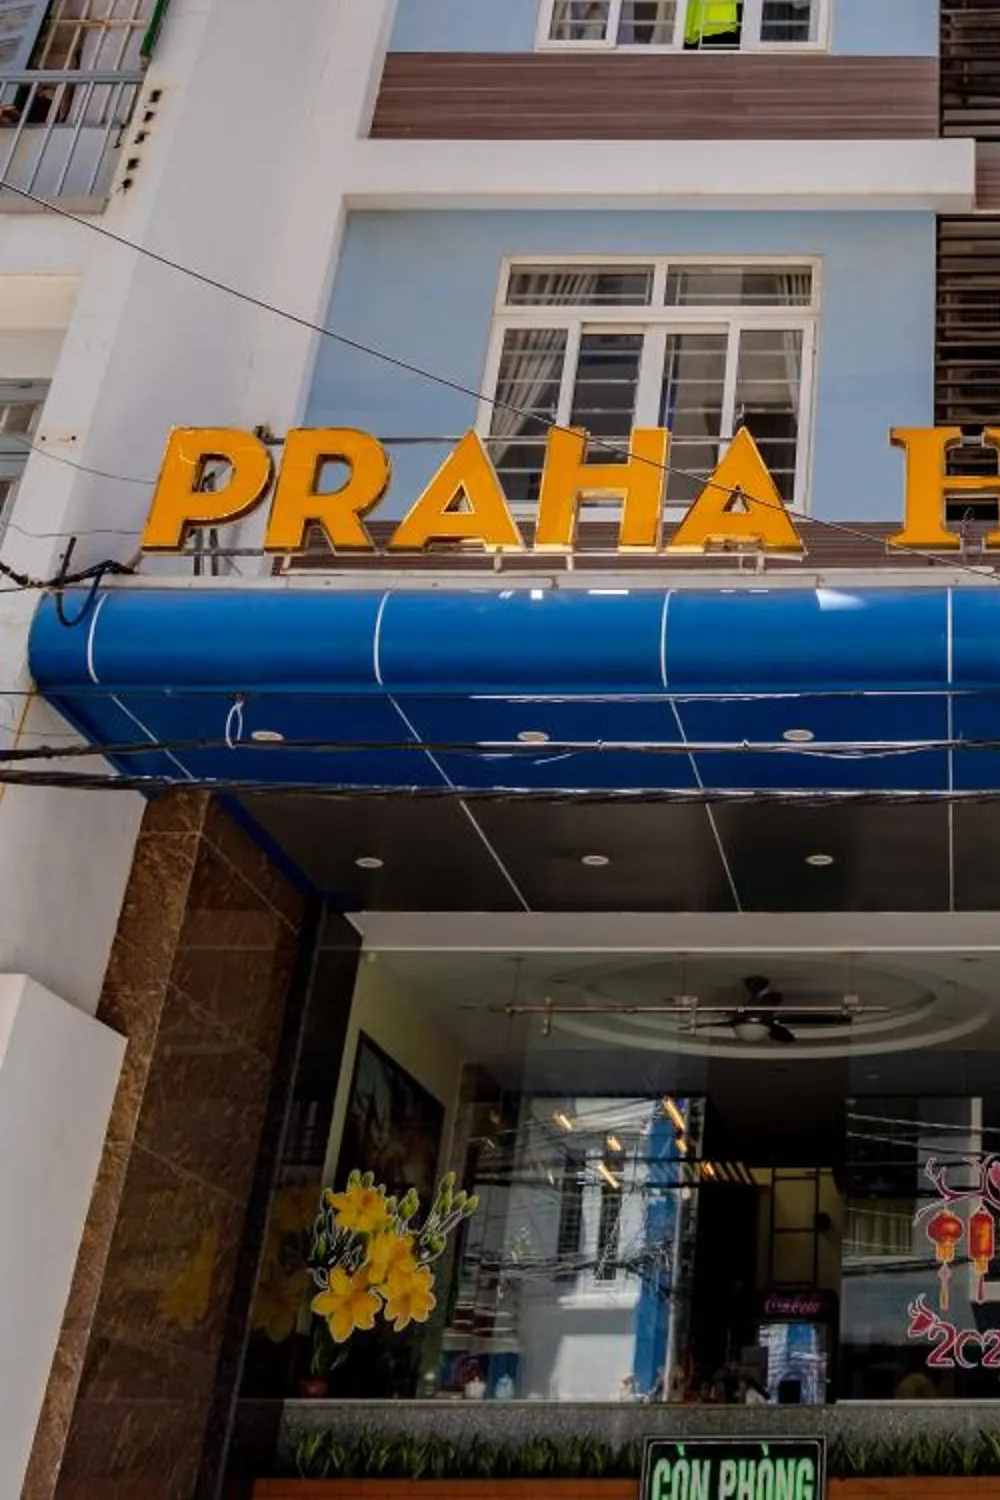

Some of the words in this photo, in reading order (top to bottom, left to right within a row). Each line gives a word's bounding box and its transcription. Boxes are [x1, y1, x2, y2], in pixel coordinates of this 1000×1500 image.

[140, 425, 807, 556] PRAHA
[651, 1441, 712, 1500] CÒN
[717, 1441, 815, 1500] PHÒNG
